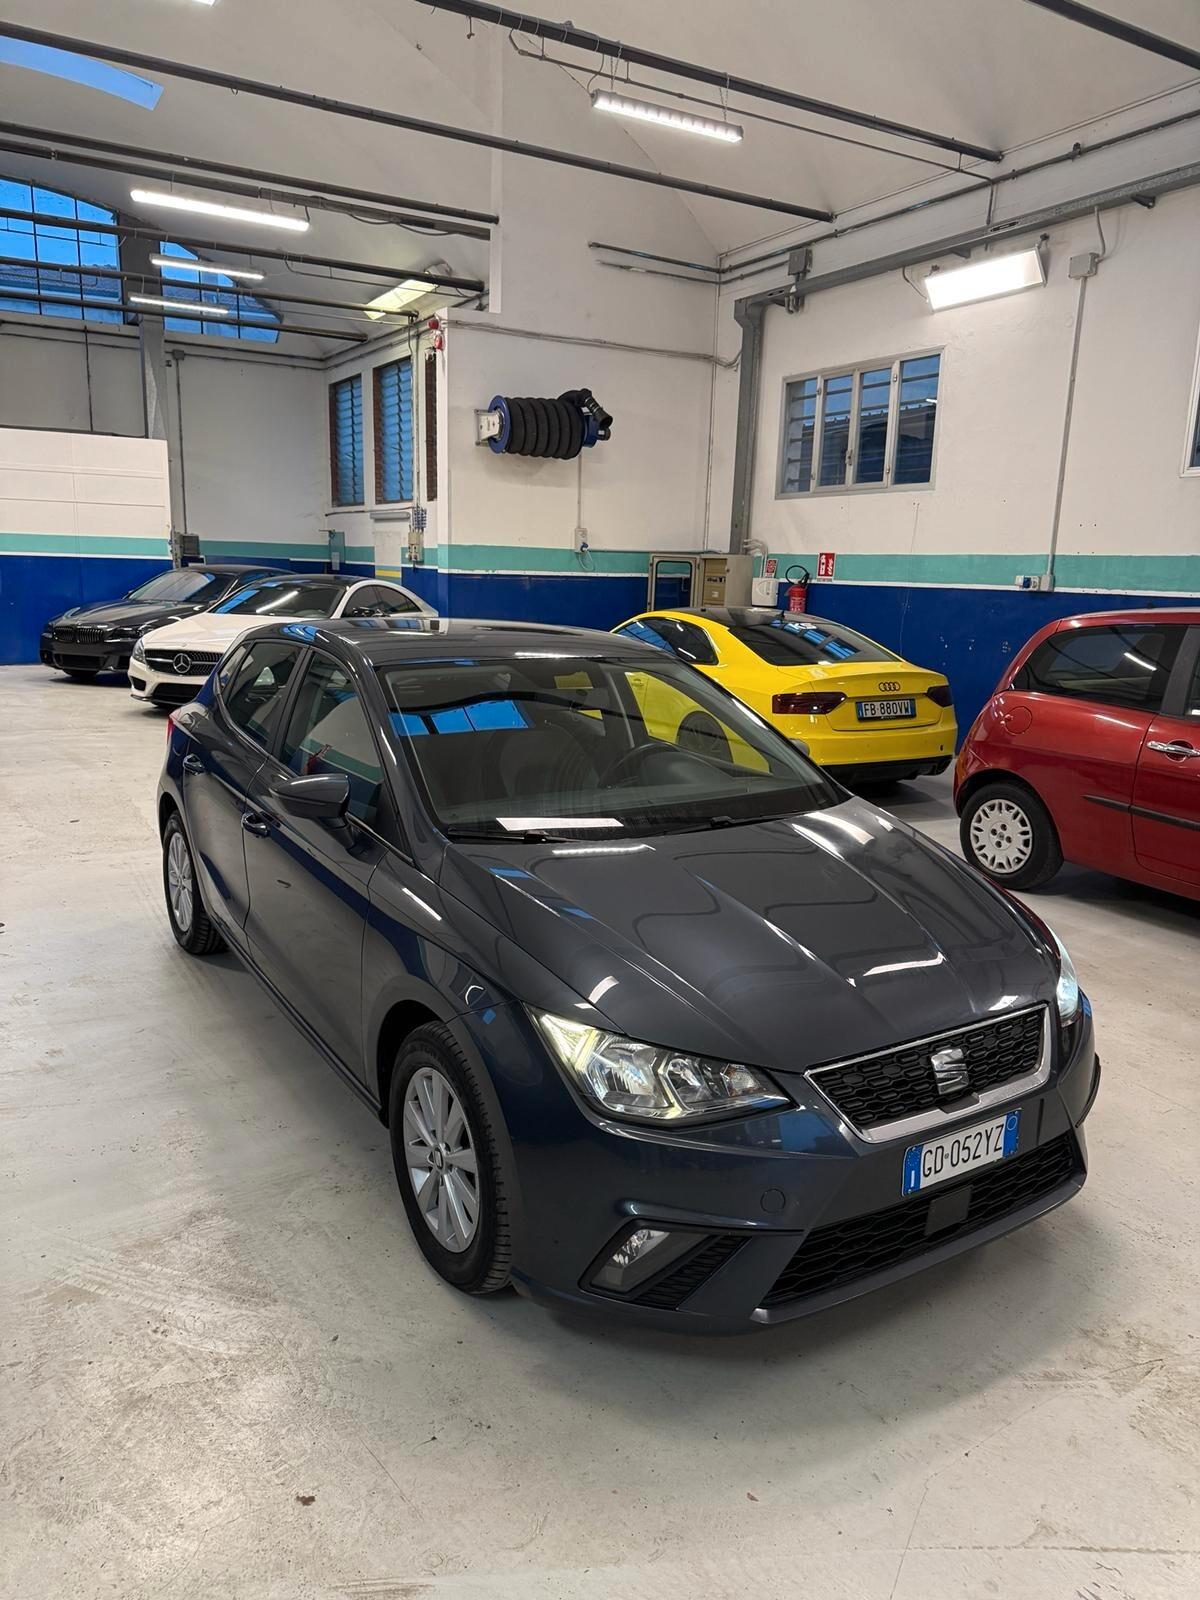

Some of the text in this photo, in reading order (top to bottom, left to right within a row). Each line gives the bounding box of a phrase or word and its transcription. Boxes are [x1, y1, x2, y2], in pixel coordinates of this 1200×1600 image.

[863, 703, 876, 716] FB
[922, 1145, 945, 1178] GD
[950, 1123, 1005, 1167] 052YZ
